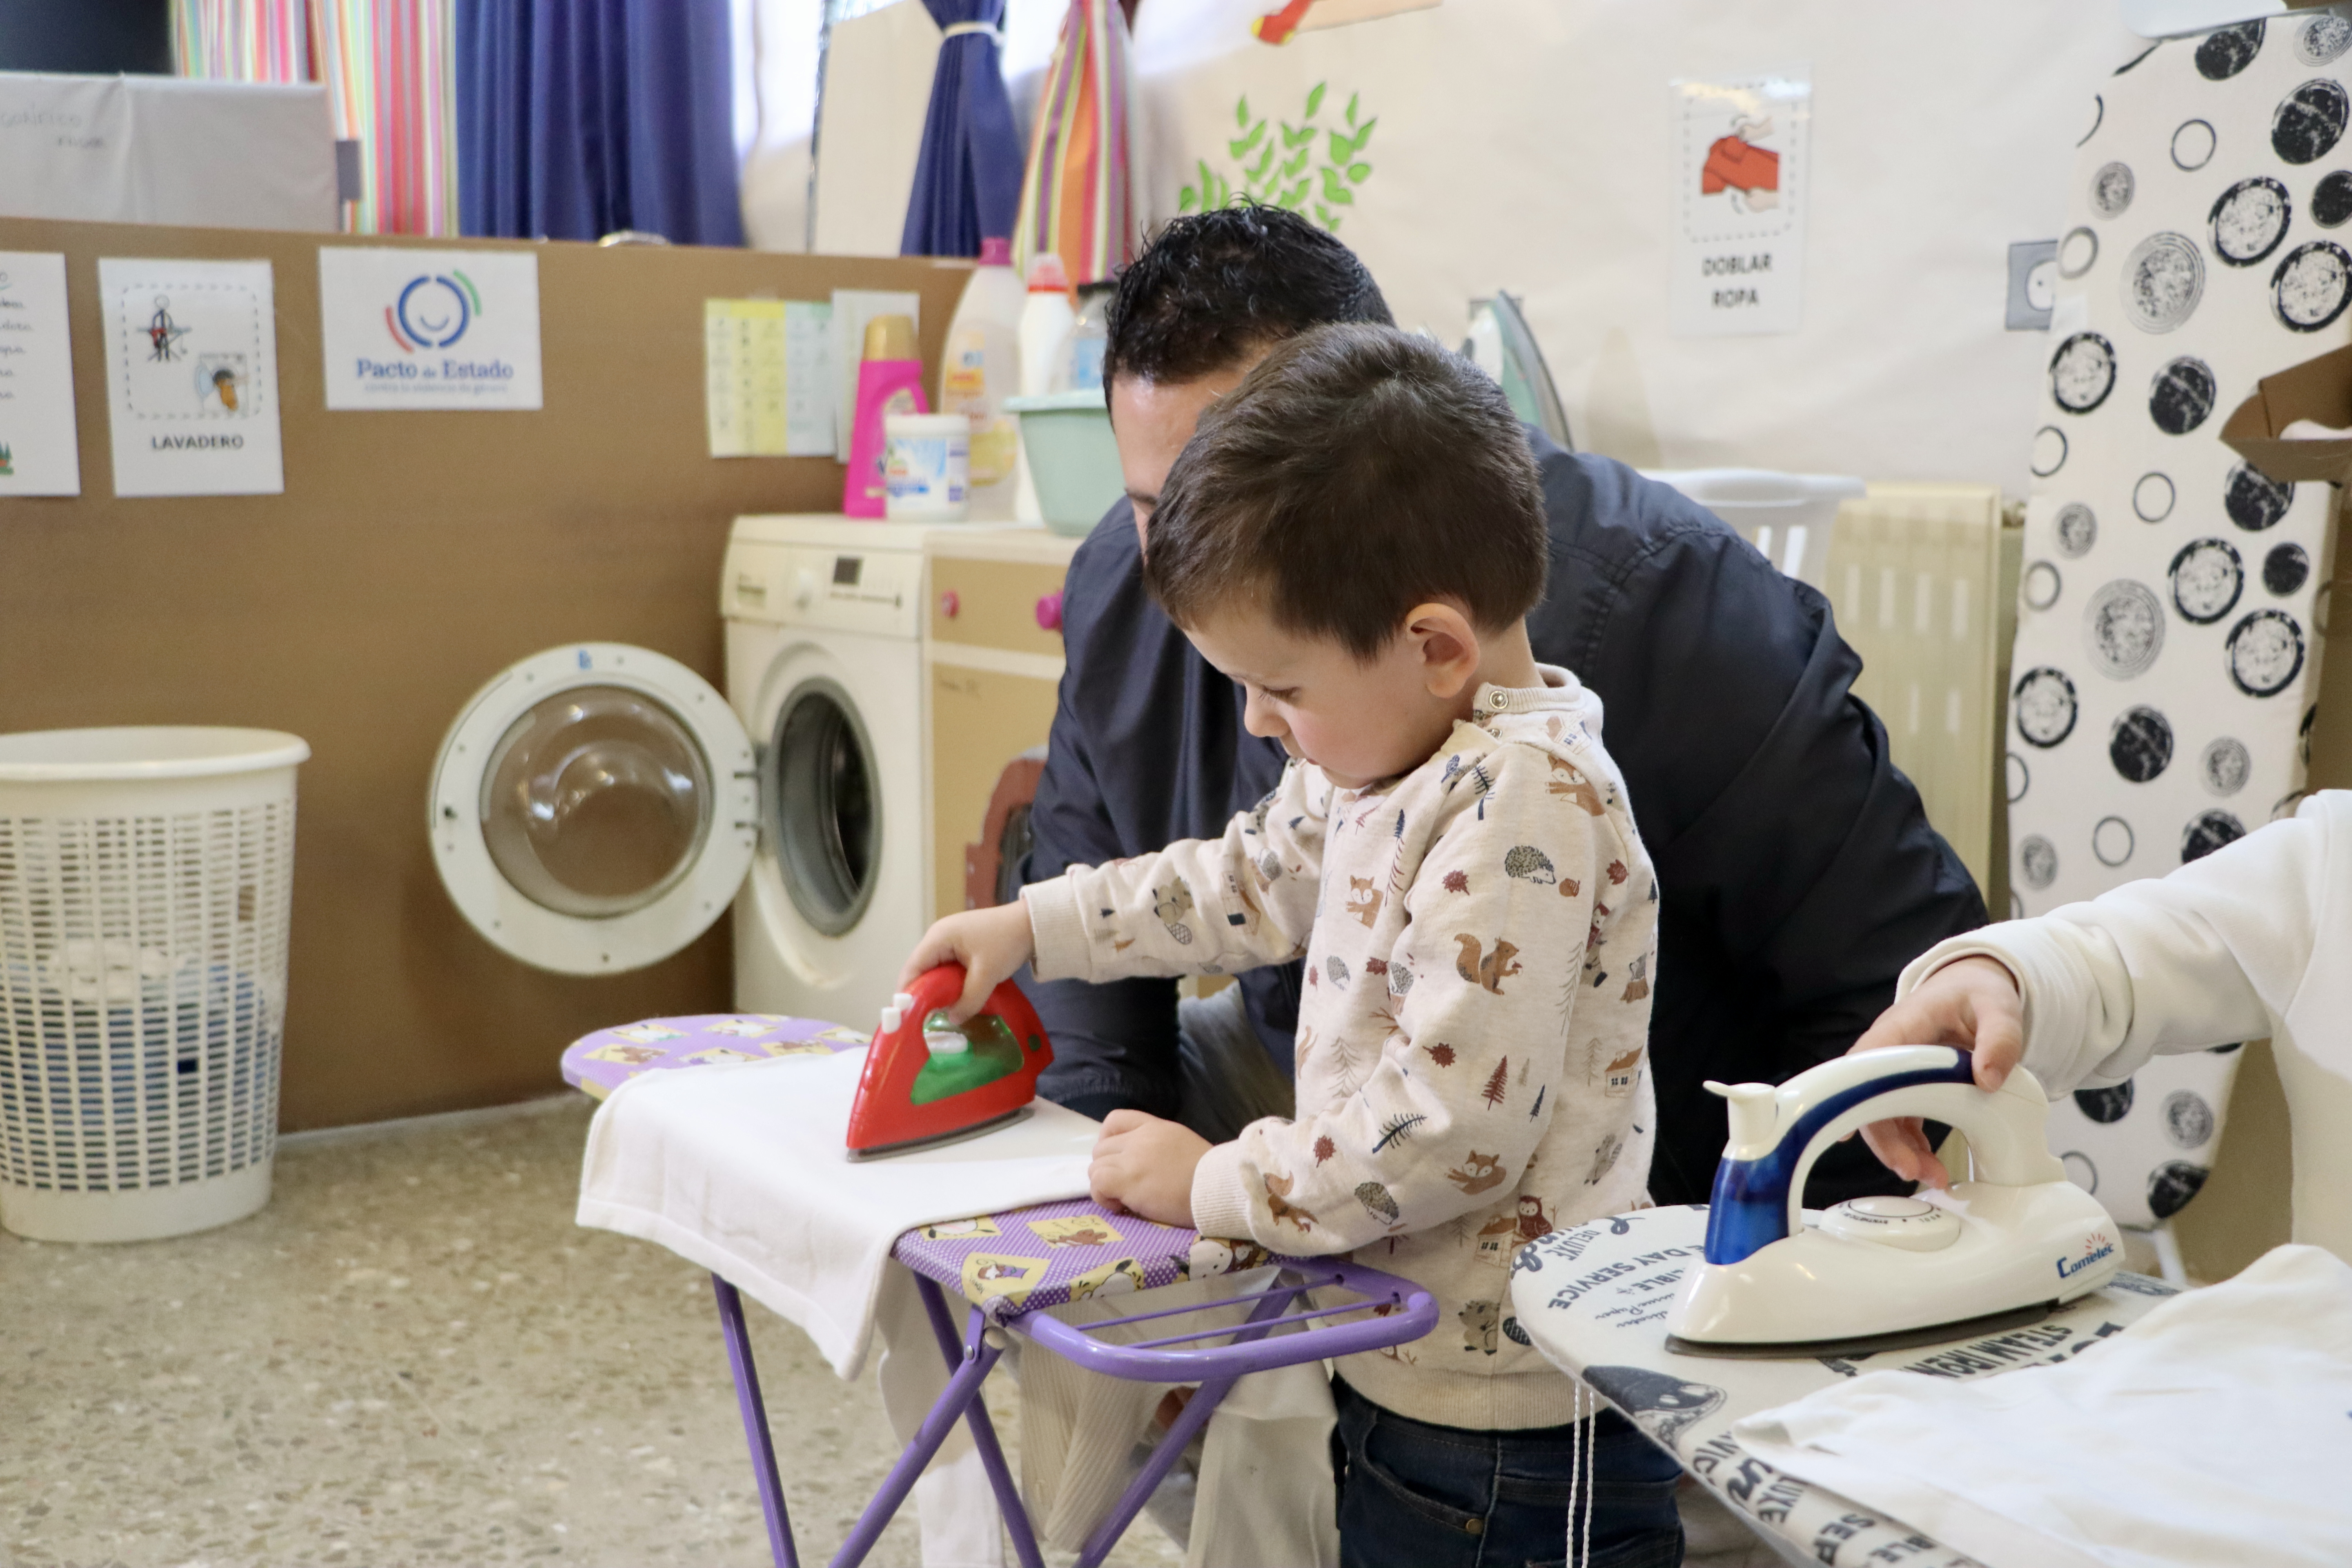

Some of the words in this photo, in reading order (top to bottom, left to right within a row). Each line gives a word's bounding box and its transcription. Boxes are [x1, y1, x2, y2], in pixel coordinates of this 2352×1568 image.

[1702, 253, 1772, 276] DOBLAR
[1711, 289, 1759, 309] ROPA
[356, 358, 417, 379] Pacto
[423, 365, 436, 377] de
[443, 359, 514, 379] Estado
[152, 435, 244, 450] LAVADERO
[1543, 1230, 1602, 1261] DELUXE
[1632, 1249, 1693, 1266] DAY
[1547, 1262, 1636, 1309] SERVICE
[1967, 1325, 2073, 1362] STEAM
